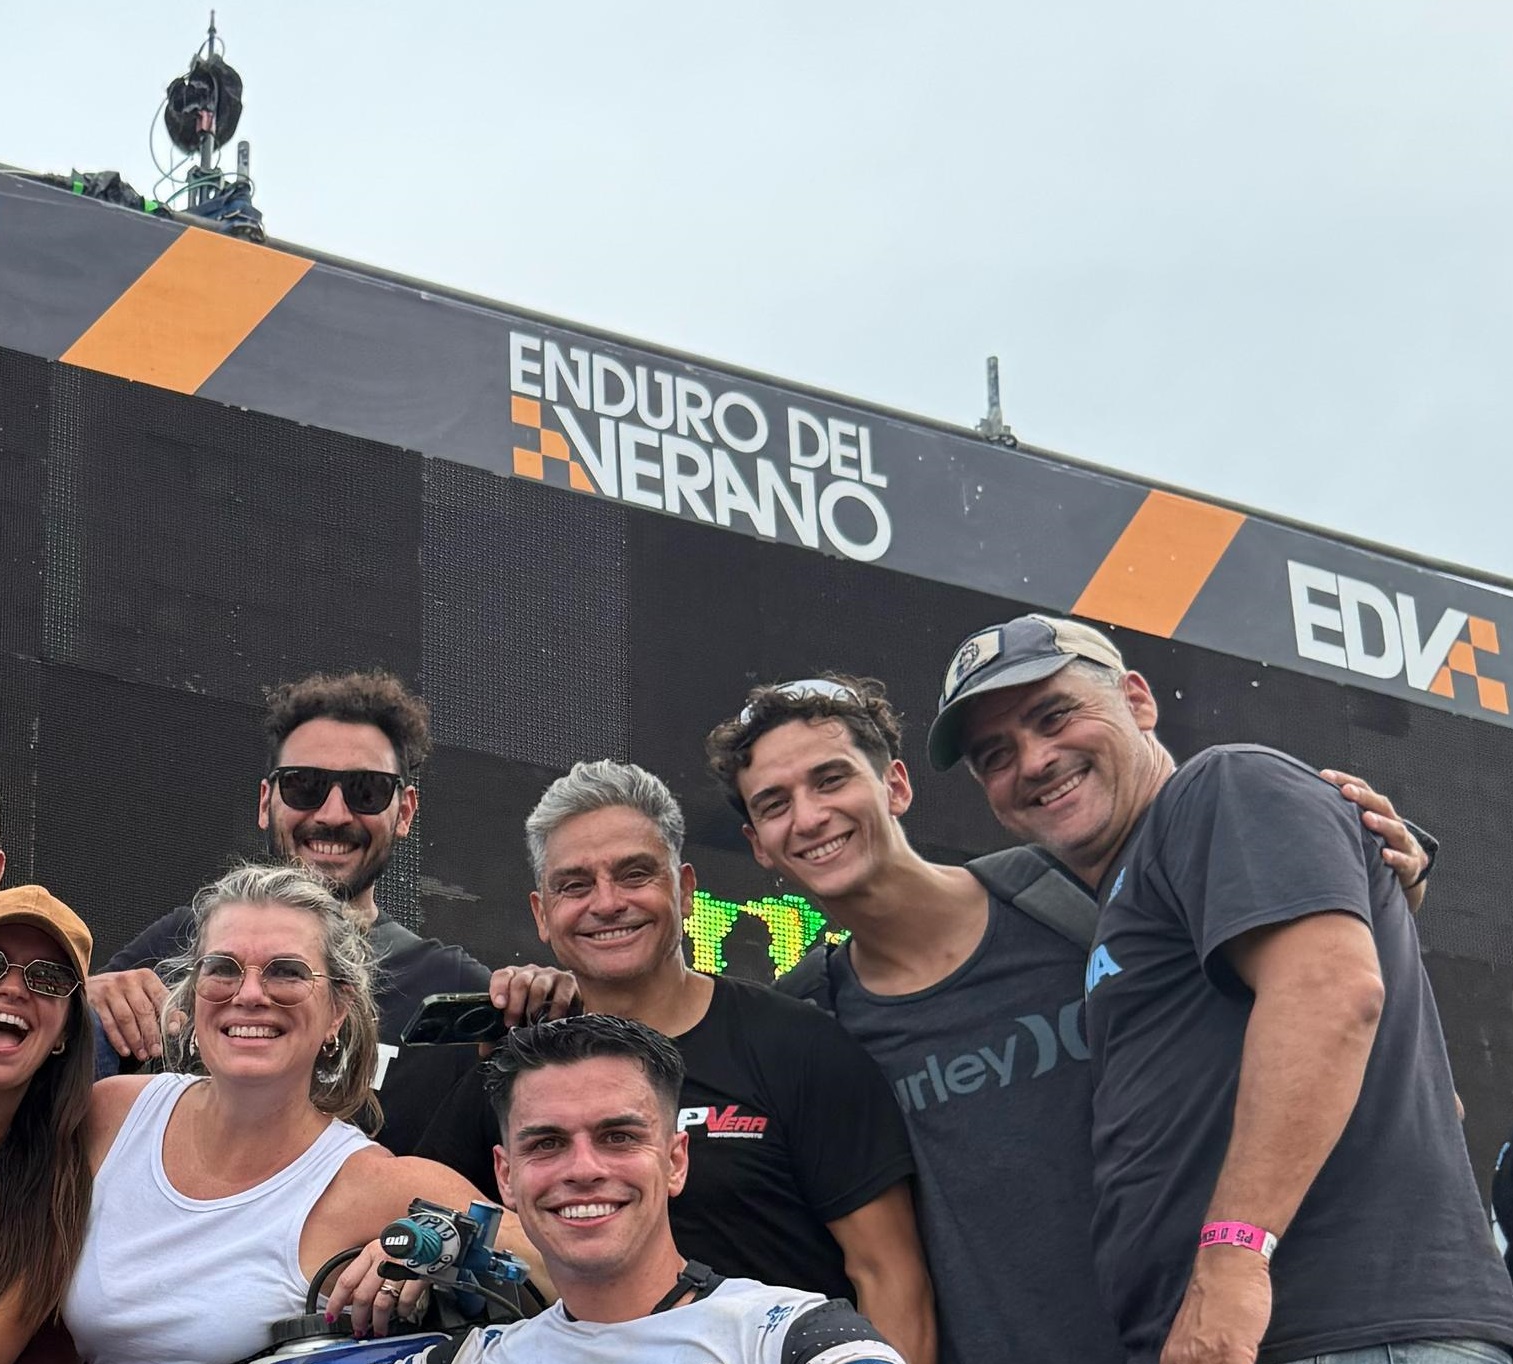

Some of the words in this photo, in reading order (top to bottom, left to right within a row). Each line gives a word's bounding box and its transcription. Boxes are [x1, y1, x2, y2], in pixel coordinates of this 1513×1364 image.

[509, 332, 769, 453] ENDURO
[788, 406, 888, 489] DEL
[555, 405, 892, 563] VERANO
[1287, 558, 1468, 690] EDV
